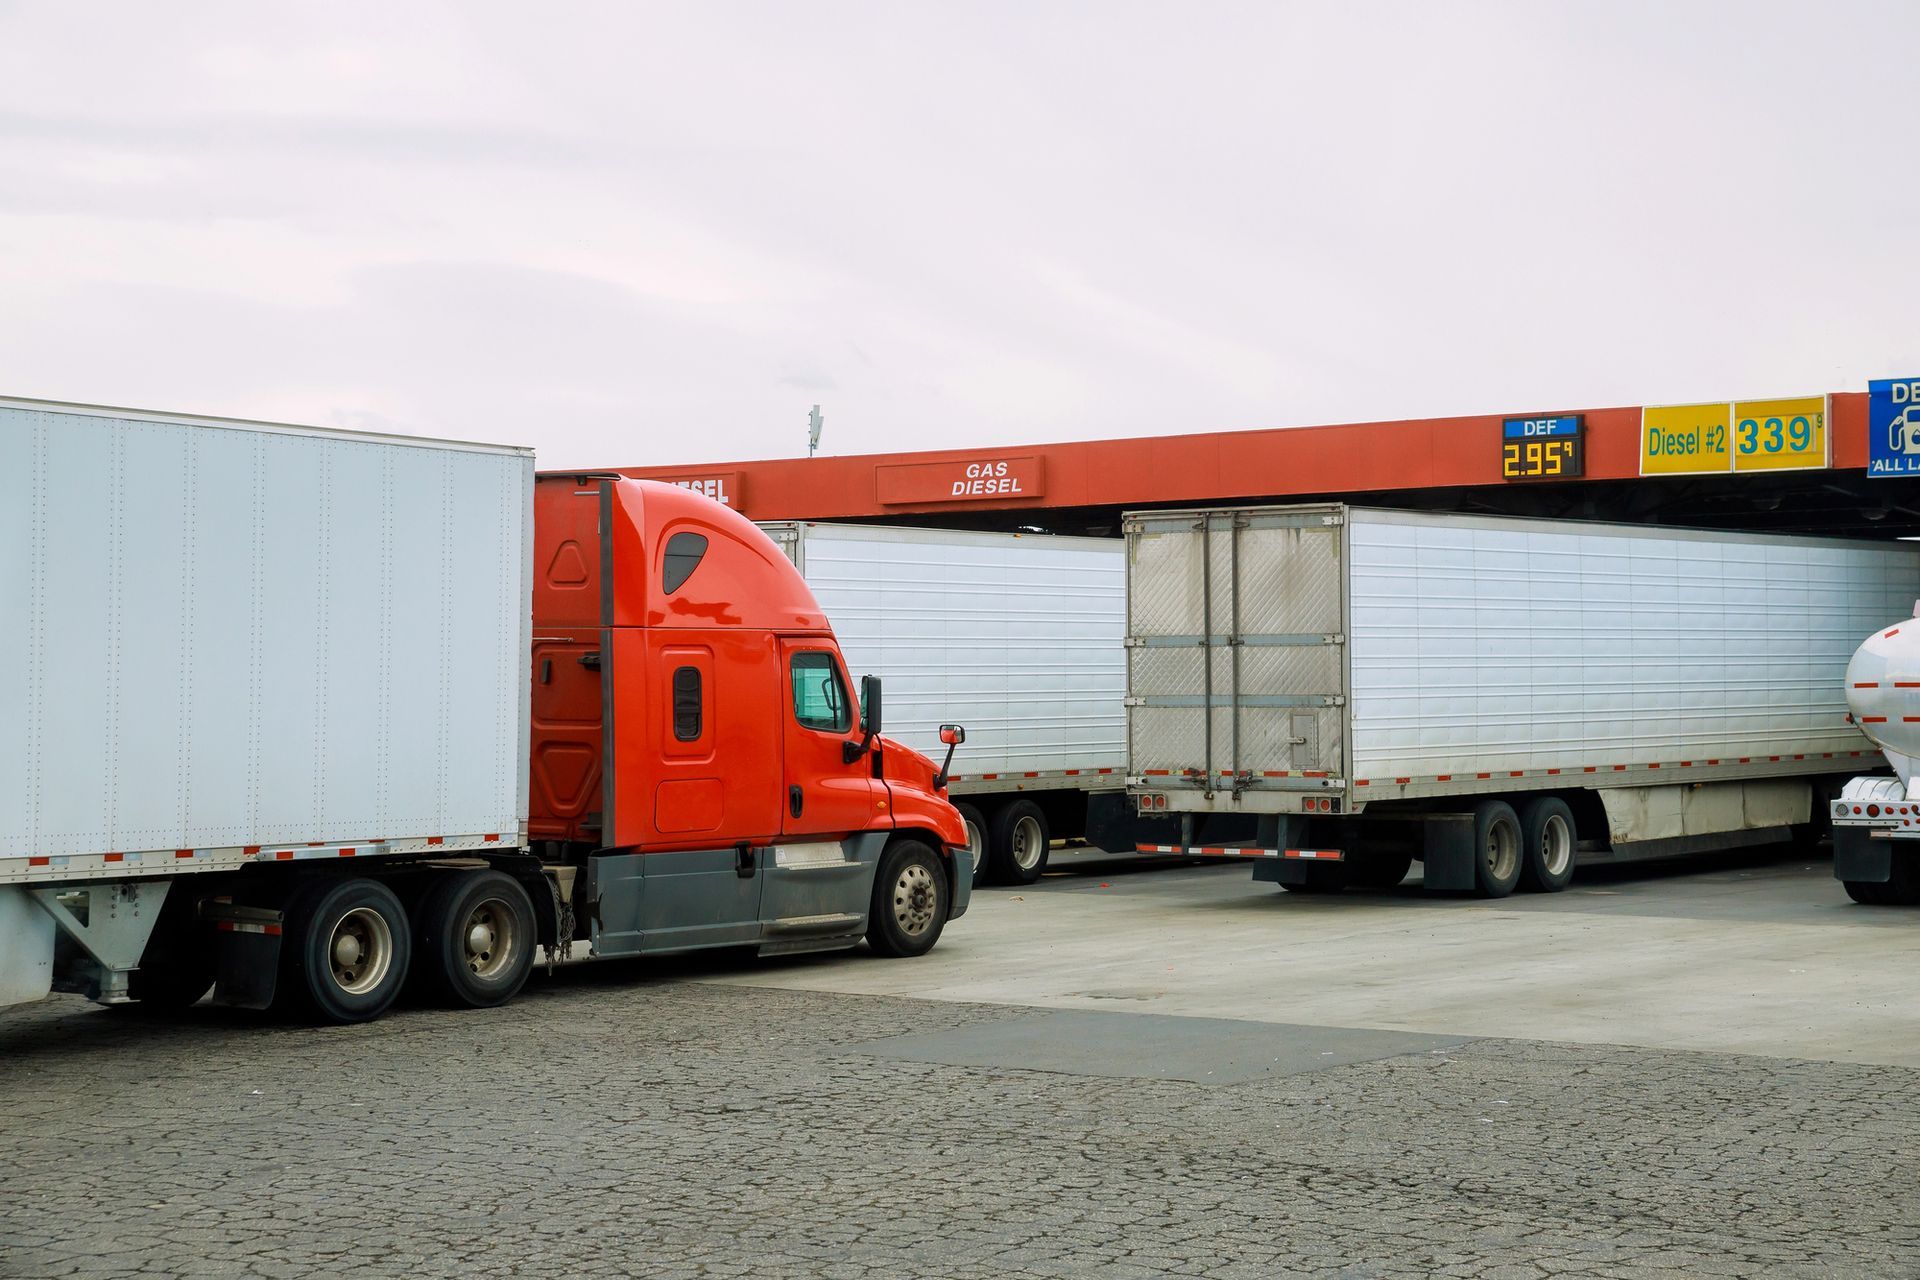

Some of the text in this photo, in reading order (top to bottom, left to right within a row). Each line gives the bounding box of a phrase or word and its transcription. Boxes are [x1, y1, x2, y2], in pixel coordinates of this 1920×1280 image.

[1524, 420, 1557, 436] DEF
[1649, 424, 1725, 456] Diesel #2
[966, 462, 1008, 478] GAS
[1873, 458, 1904, 472] ALL
[952, 478, 1022, 496] DIESEL
